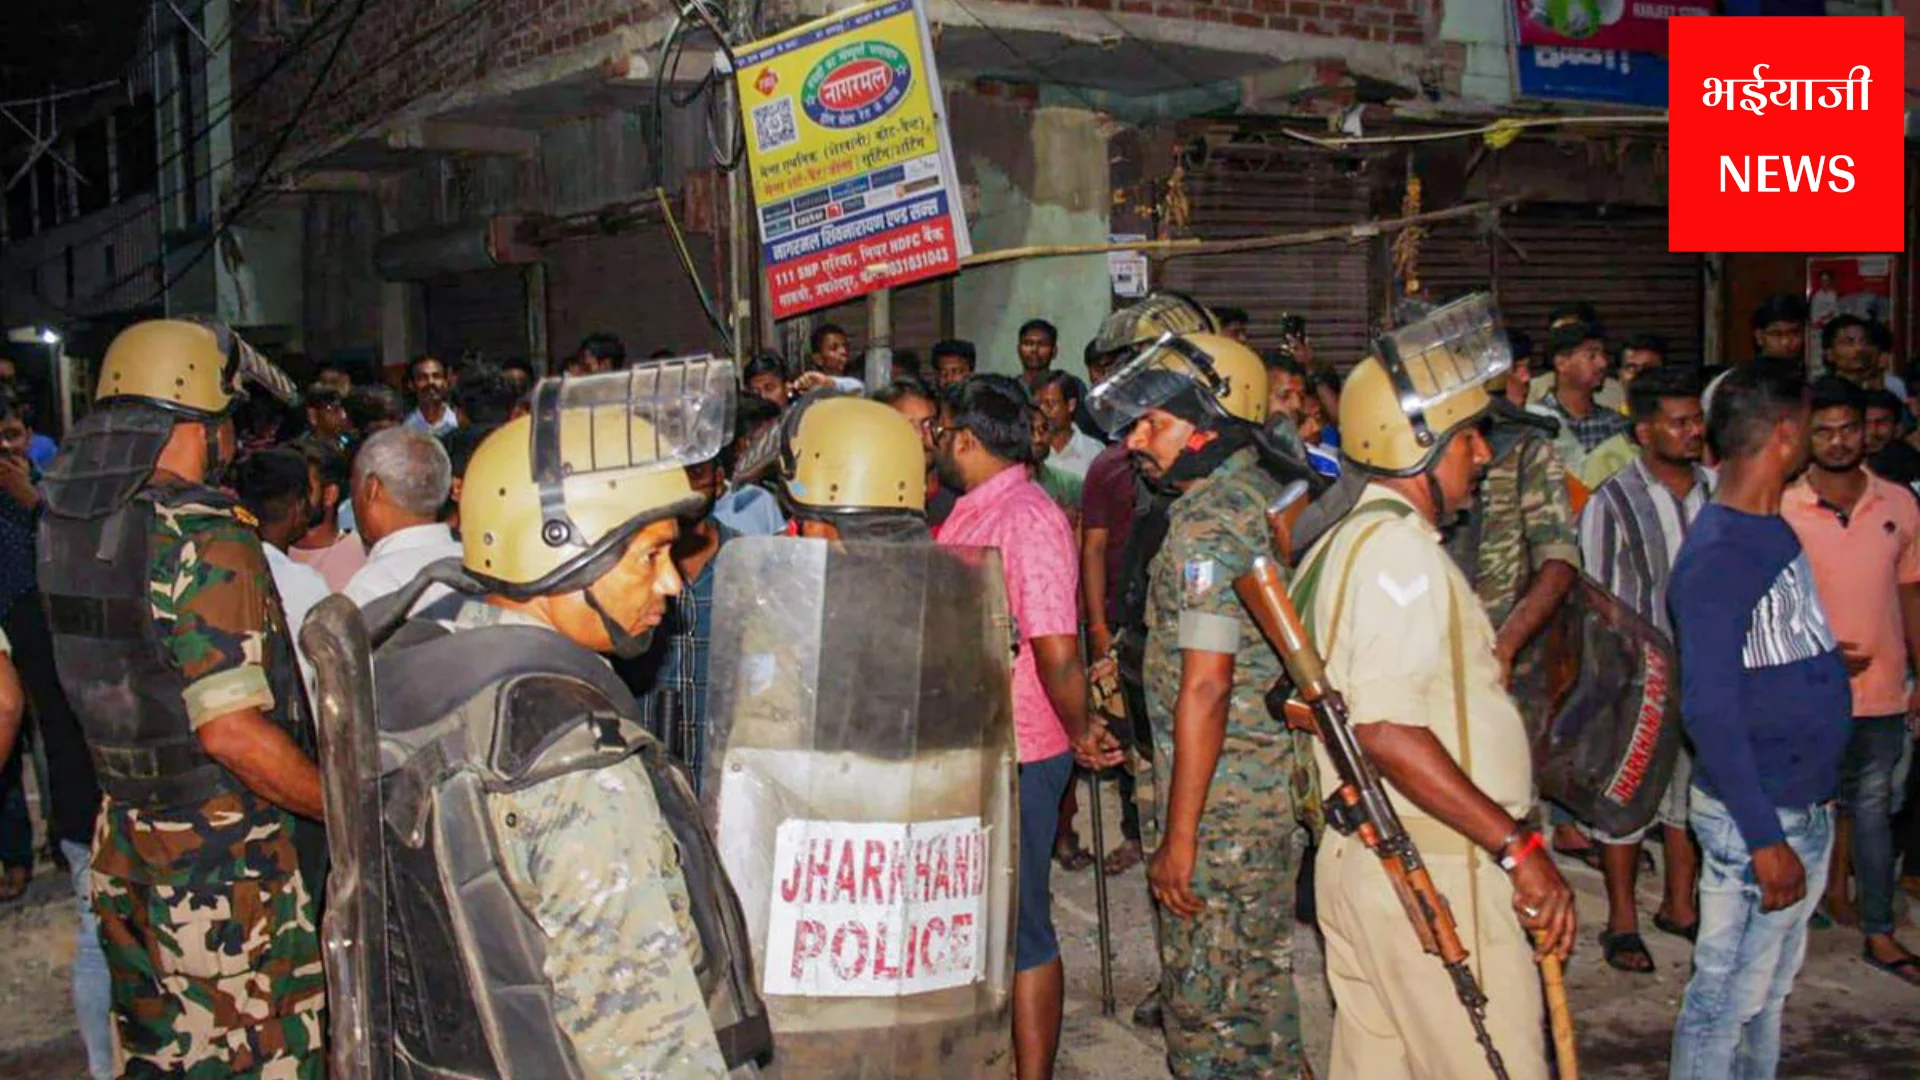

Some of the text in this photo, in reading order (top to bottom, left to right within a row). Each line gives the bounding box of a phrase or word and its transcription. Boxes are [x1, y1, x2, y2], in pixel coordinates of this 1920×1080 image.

[822, 66, 887, 104] नागरमल
[772, 235, 820, 262] नागरमल
[775, 269, 795, 287] 111
[890, 234, 921, 254] HDFC
[781, 833, 986, 905] JHARKHAND
[790, 912, 974, 981] POLICE
